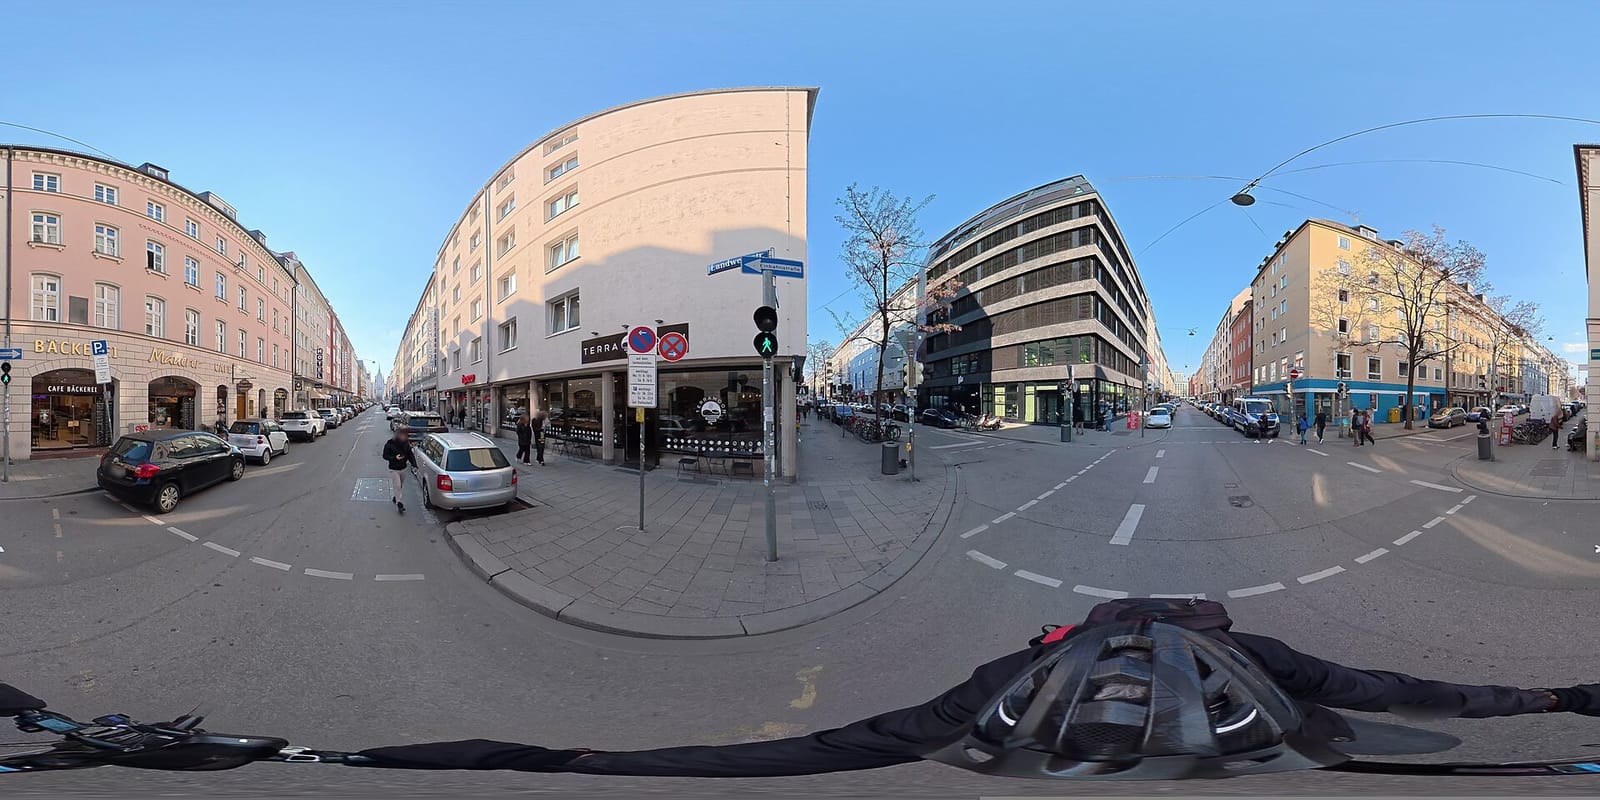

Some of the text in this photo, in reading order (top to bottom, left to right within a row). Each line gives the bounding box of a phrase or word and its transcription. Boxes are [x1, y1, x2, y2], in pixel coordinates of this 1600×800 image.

[760, 263, 800, 272] Einbahnstraße
[34, 339, 118, 359] BÄCKEI
[583, 342, 619, 356] TERRA
[47, 384, 98, 393] CAFE BÄCKEREI
